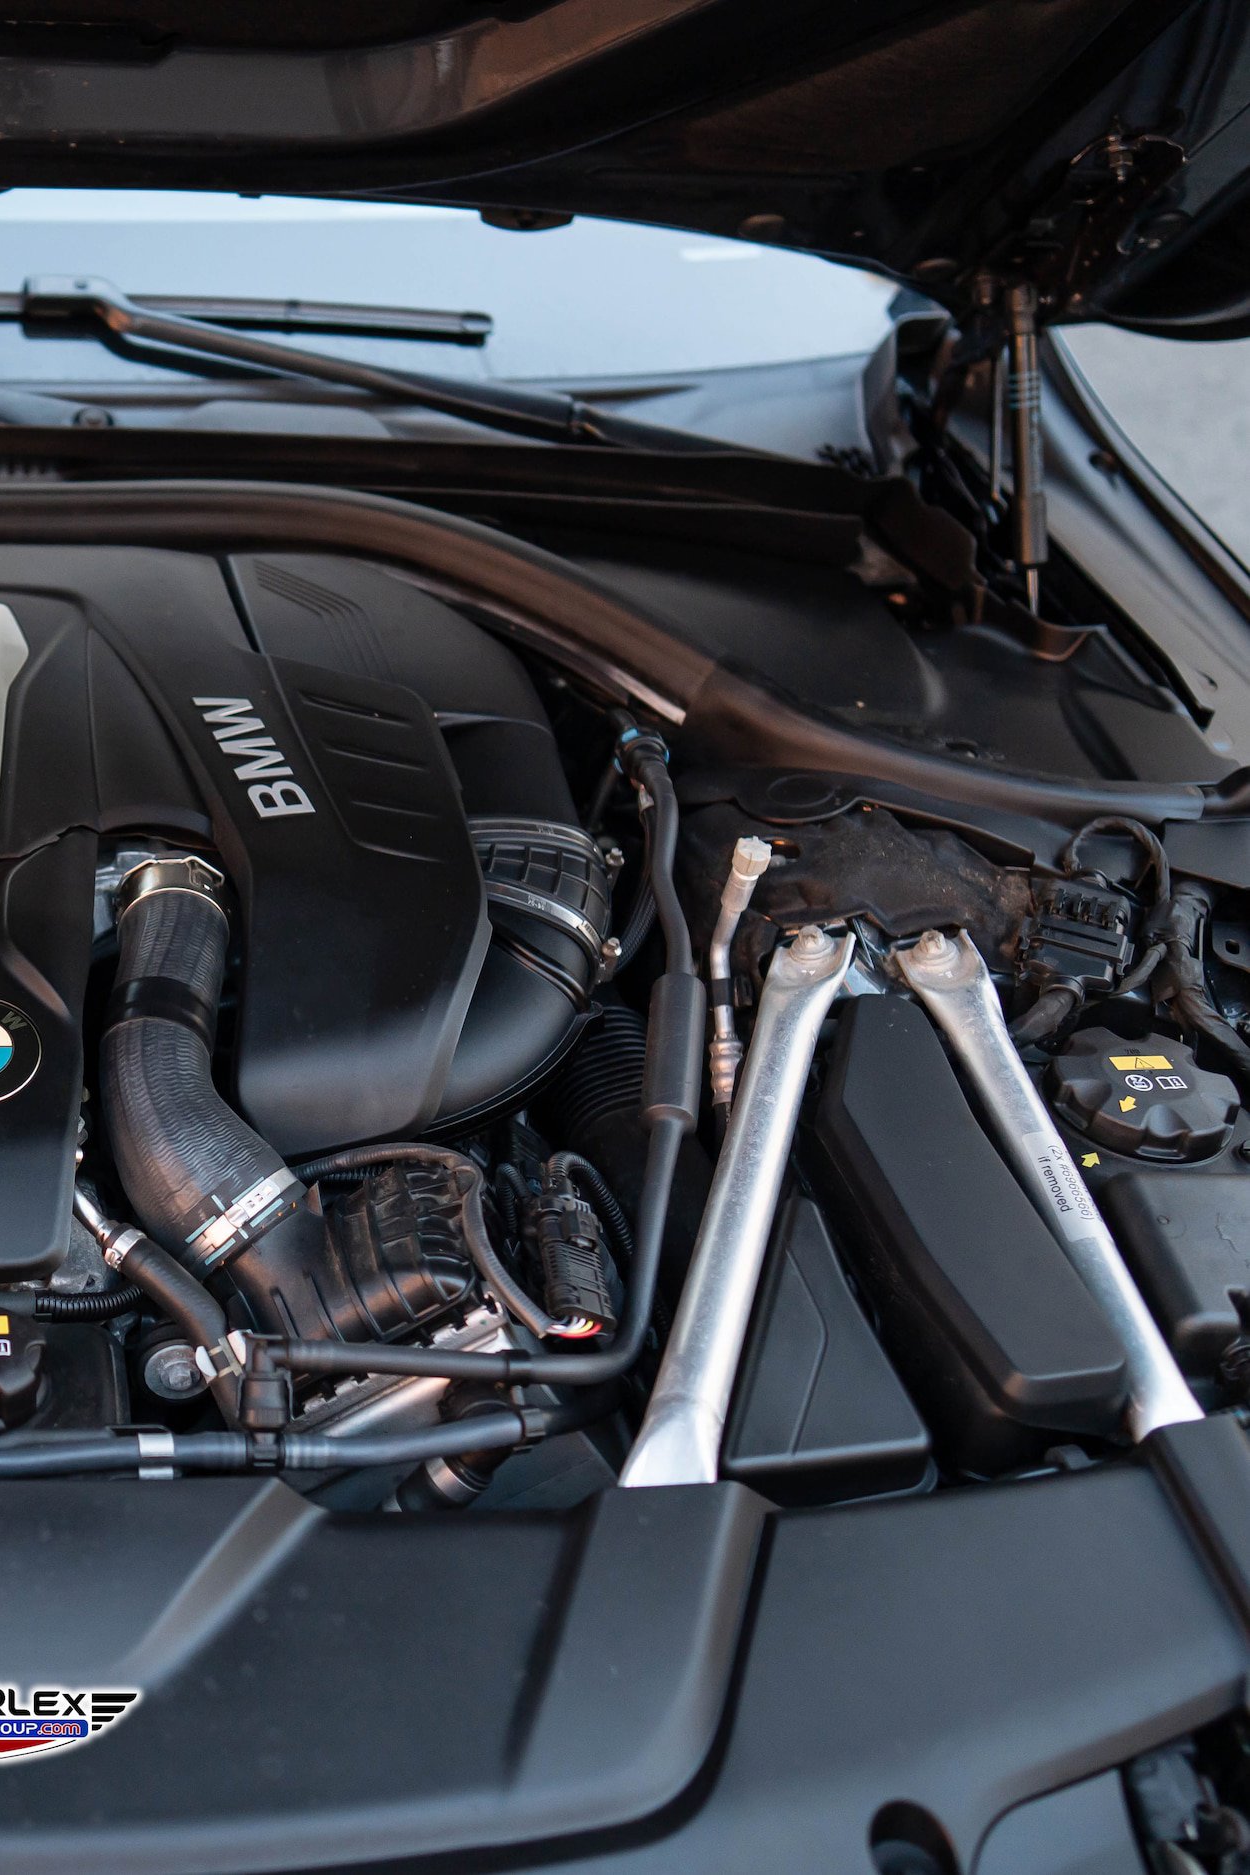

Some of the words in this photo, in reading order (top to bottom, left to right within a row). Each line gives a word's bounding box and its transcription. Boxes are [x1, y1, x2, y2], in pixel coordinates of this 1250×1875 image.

[191, 696, 316, 818] BMW
[1037, 1155, 1051, 1164] if
[1042, 1165, 1074, 1213] removed
